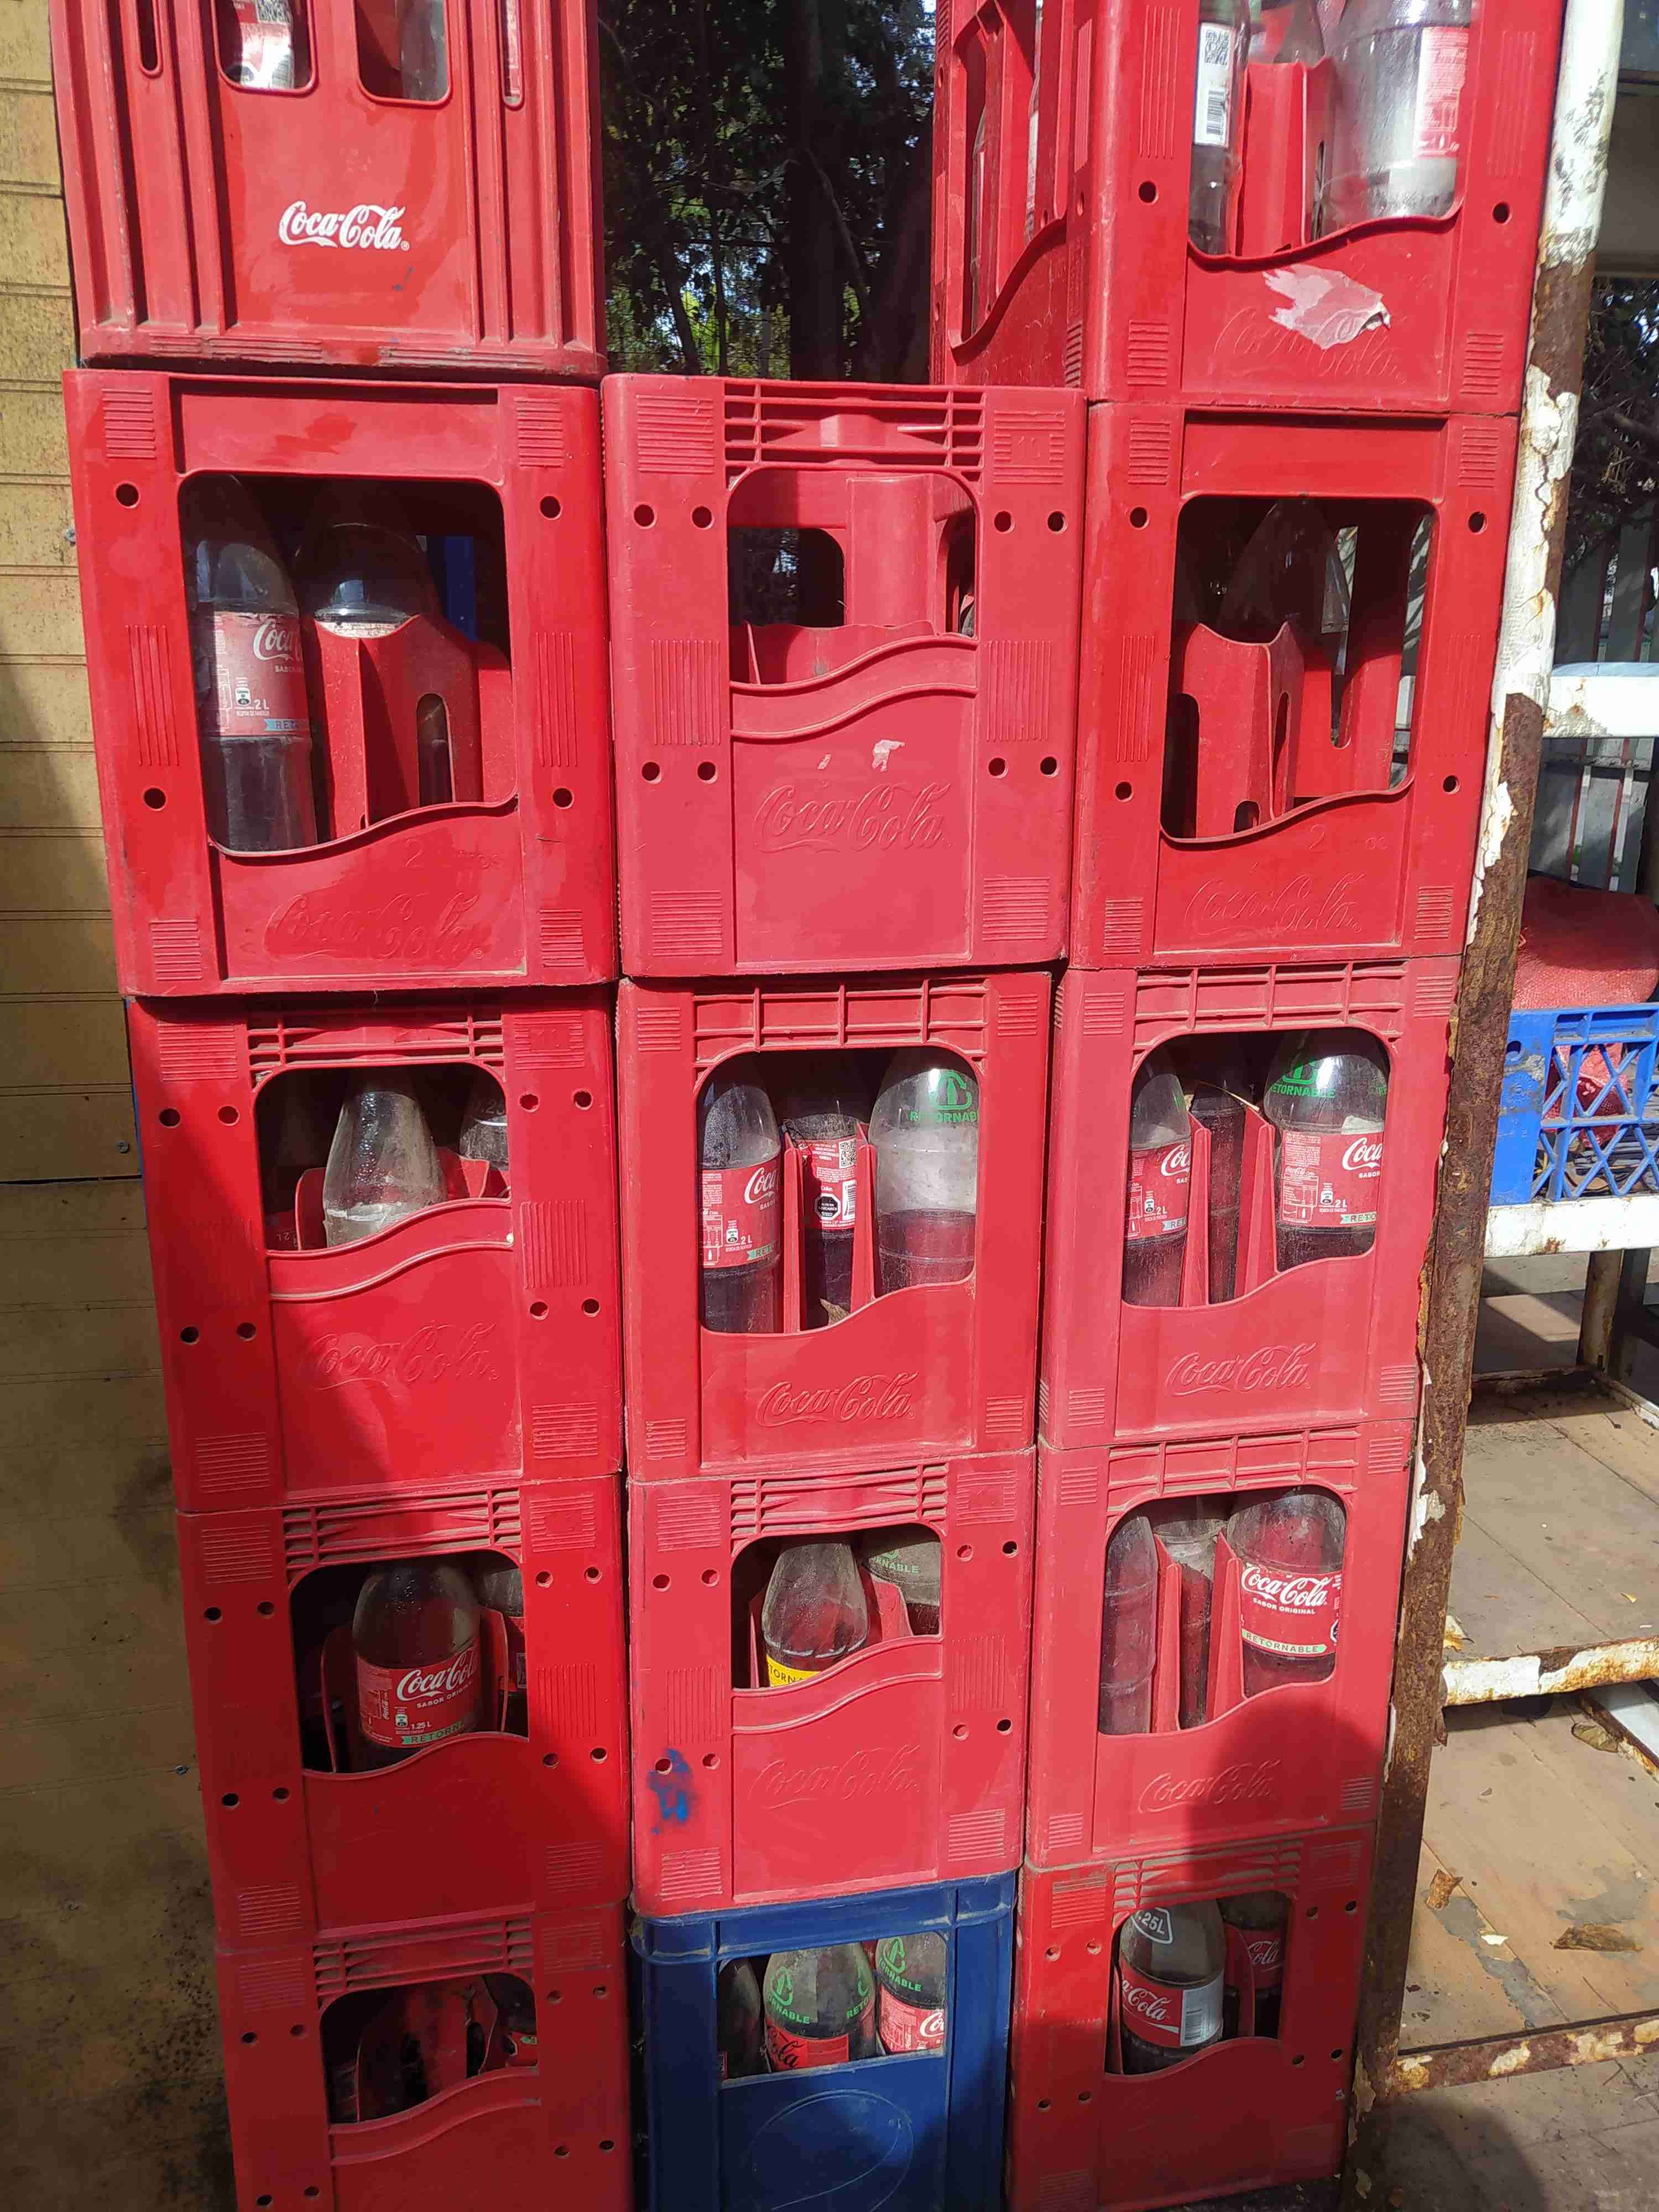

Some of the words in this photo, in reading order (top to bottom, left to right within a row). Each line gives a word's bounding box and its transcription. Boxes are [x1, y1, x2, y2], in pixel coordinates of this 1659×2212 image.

[1165, 1340, 1317, 1397] Coca-Cola
[755, 1371, 919, 1428] Coca-Cola
[1241, 1566, 1333, 1607] Coca-Cola
[1253, 1598, 1277, 1610] SABOR
[1279, 1605, 1316, 1615] ORIGINAL
[1246, 1632, 1319, 1653] RETORNABLE
[416, 1698, 445, 1708] SABOR
